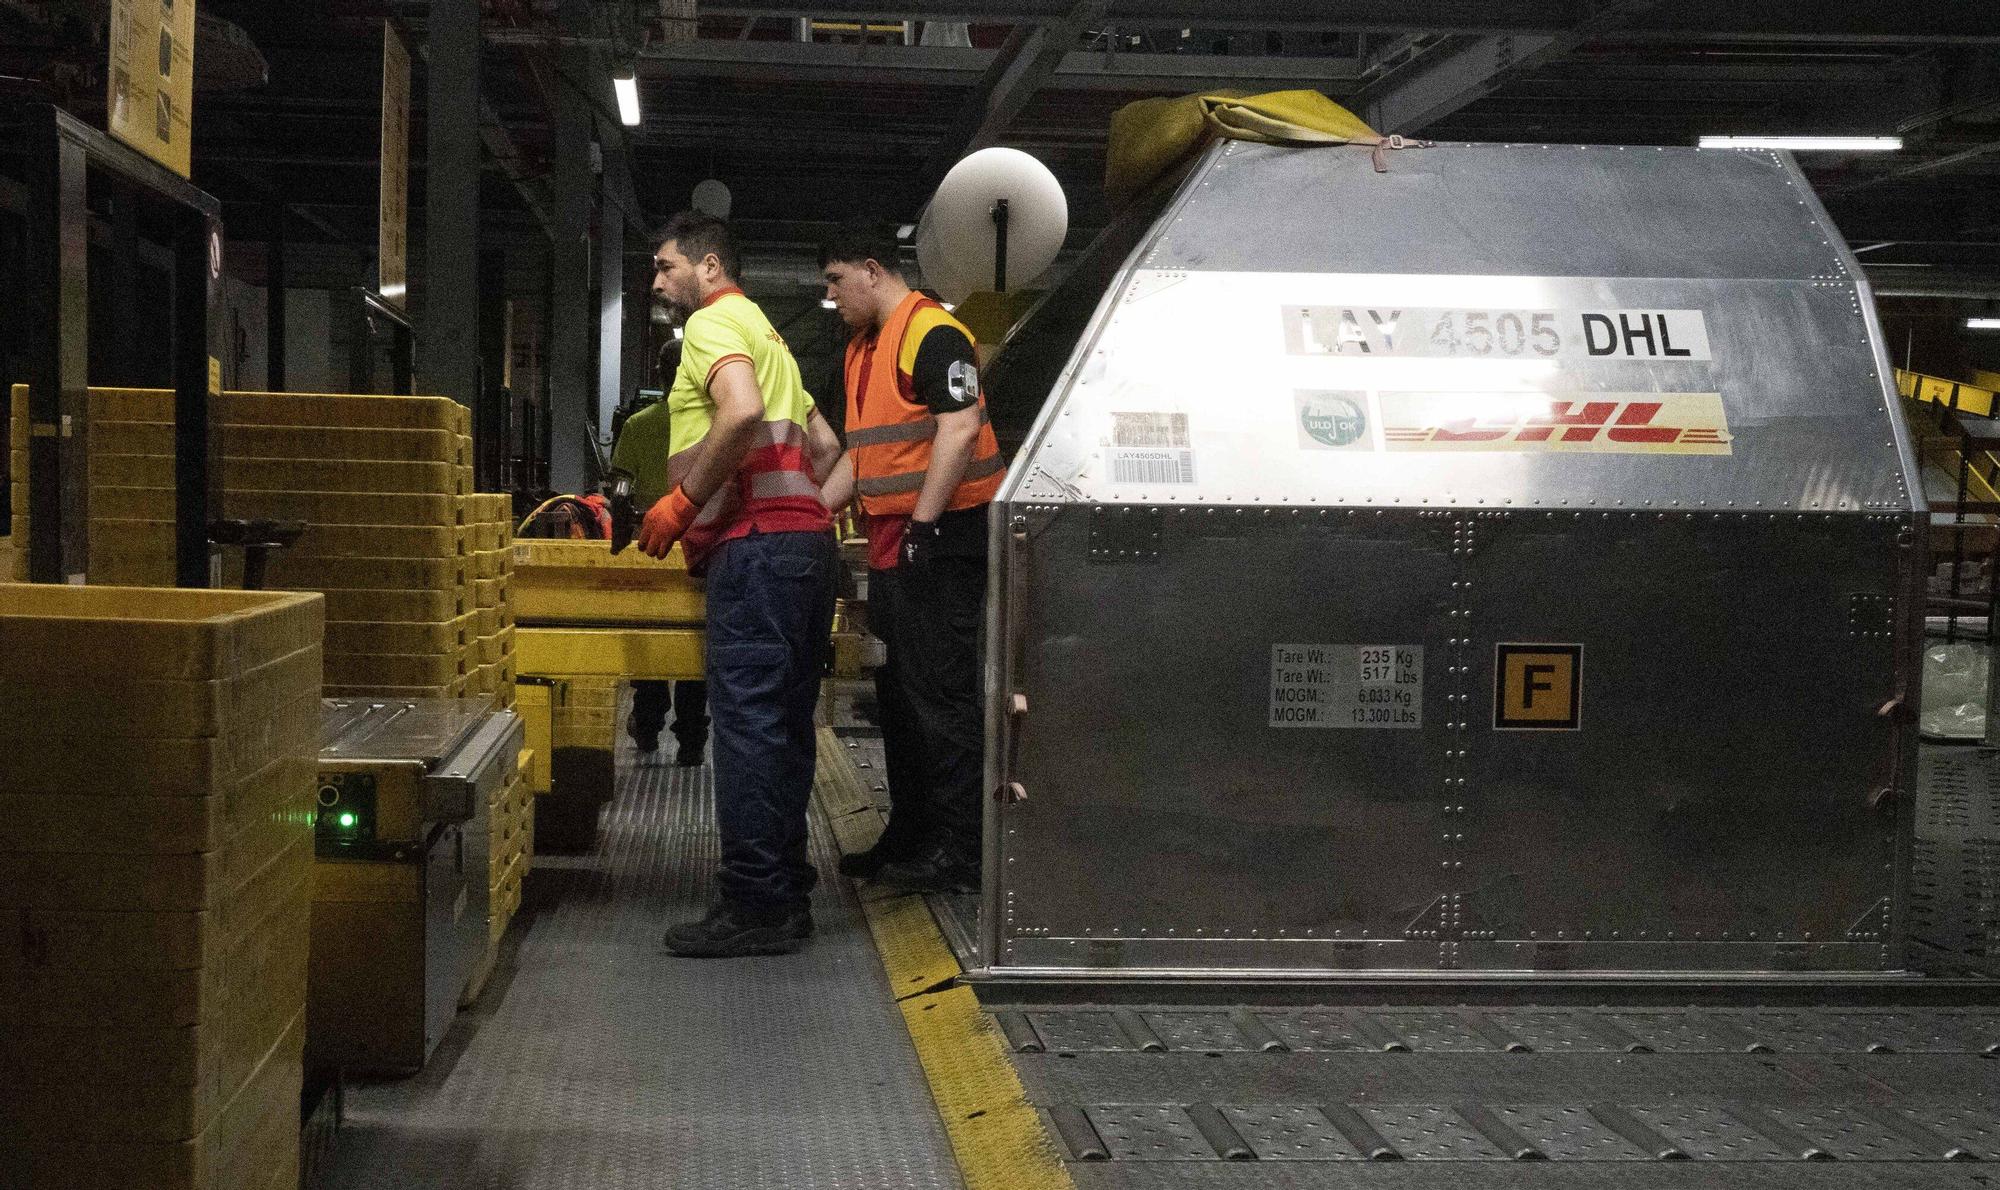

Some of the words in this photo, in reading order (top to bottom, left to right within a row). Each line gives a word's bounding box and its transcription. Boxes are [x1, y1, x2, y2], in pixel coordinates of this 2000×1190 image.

[1302, 309, 1402, 353] LAY
[1430, 312, 1561, 356] 4505
[1581, 313, 1691, 357] DHL
[1309, 420, 1331, 430] ULD
[1339, 421, 1357, 431] OK
[1431, 402, 1684, 443] DHL
[1117, 451, 1173, 460] LAY4505DHL
[1277, 649, 1303, 664] Tare
[1362, 650, 1391, 664] 235
[1396, 650, 1414, 668] Kg
[1276, 668, 1303, 683] Tare
[1362, 666, 1391, 680] 517
[1395, 670, 1418, 684] Lbs
[1522, 664, 1556, 710] F
[1358, 689, 1391, 703] 6.033
[1394, 689, 1412, 707] Kg
[1351, 708, 1390, 723] 13.300
[1393, 709, 1416, 723] Lbs
